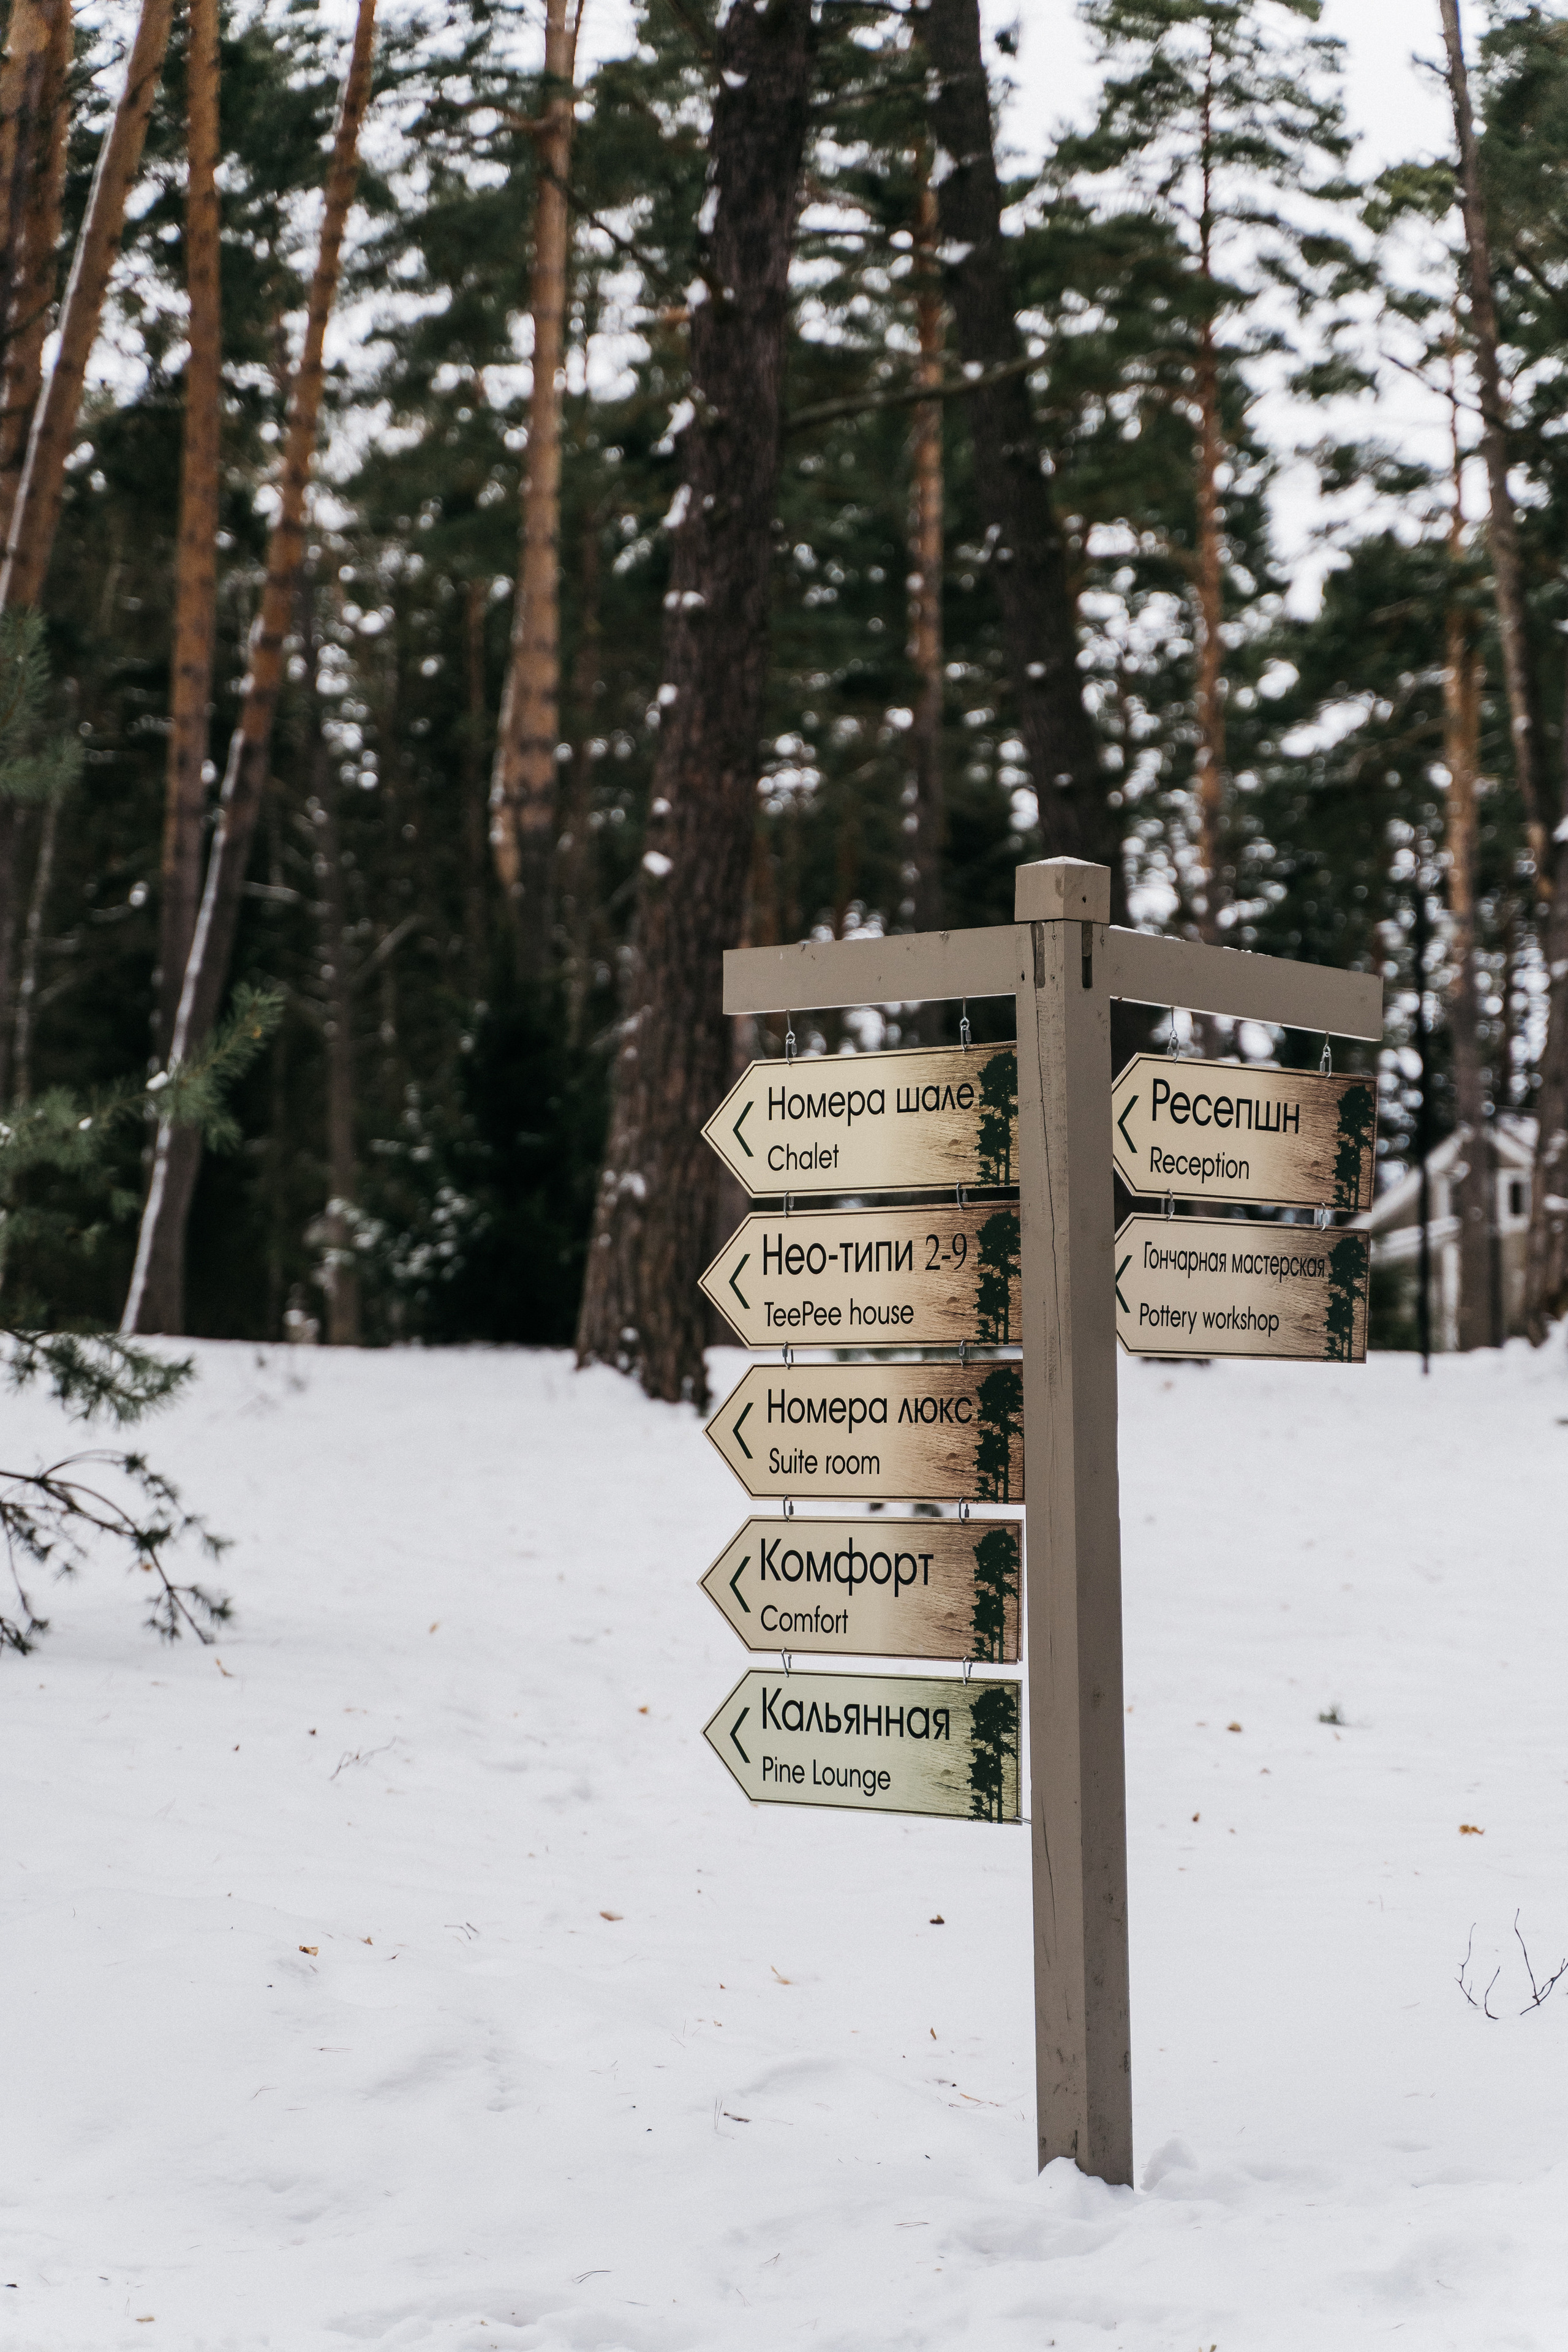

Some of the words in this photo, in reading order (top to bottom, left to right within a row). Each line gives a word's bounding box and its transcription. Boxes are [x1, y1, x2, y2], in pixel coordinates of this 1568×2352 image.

[767, 1086, 885, 1126] Номера
[897, 1082, 974, 1113] шале
[1152, 1077, 1300, 1134] Ресепшн
[767, 1142, 839, 1171] Chalet
[1150, 1146, 1250, 1184] Reception
[763, 1233, 913, 1275] Нео-типи
[925, 1232, 968, 1271] 2-9
[1144, 1242, 1227, 1278] Гончарная
[1232, 1253, 1325, 1283] мастерская
[764, 1300, 842, 1327] TeePee
[850, 1298, 914, 1325] house
[1139, 1302, 1198, 1335] Pottery
[1202, 1305, 1280, 1337] workshop
[767, 1389, 888, 1433] Номера
[897, 1396, 973, 1424] люкс
[769, 1447, 818, 1474] Suite
[825, 1453, 880, 1475] room
[760, 1537, 934, 1597] Комфорт
[760, 1605, 849, 1634] Comfort
[762, 1687, 950, 1740] Кальянная
[762, 1756, 805, 1784] Pine
[812, 1759, 891, 1797] Lounge
